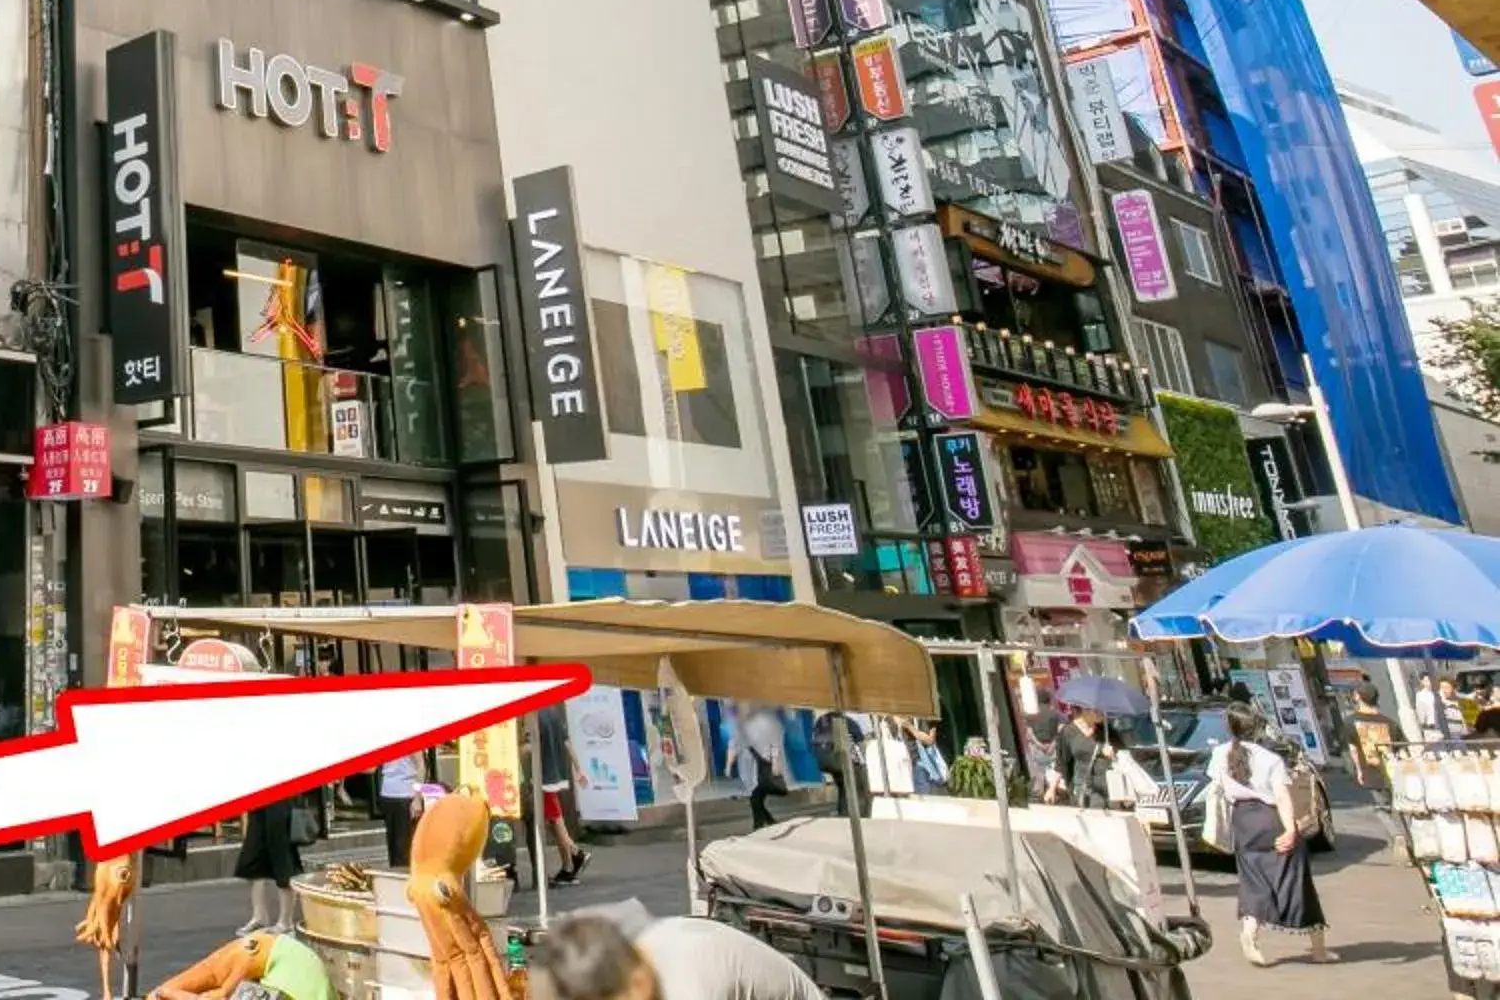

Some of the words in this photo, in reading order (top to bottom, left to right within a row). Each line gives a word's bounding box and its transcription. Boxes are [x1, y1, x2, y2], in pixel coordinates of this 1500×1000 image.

[762, 78, 822, 126] LUSH
[768, 108, 827, 154] FRESH
[527, 206, 586, 418] LANEIGE
[807, 509, 849, 523] LUSH
[1191, 484, 1256, 520] innisfree
[616, 505, 746, 553] LANEIGE
[809, 523, 852, 534] FRESH
